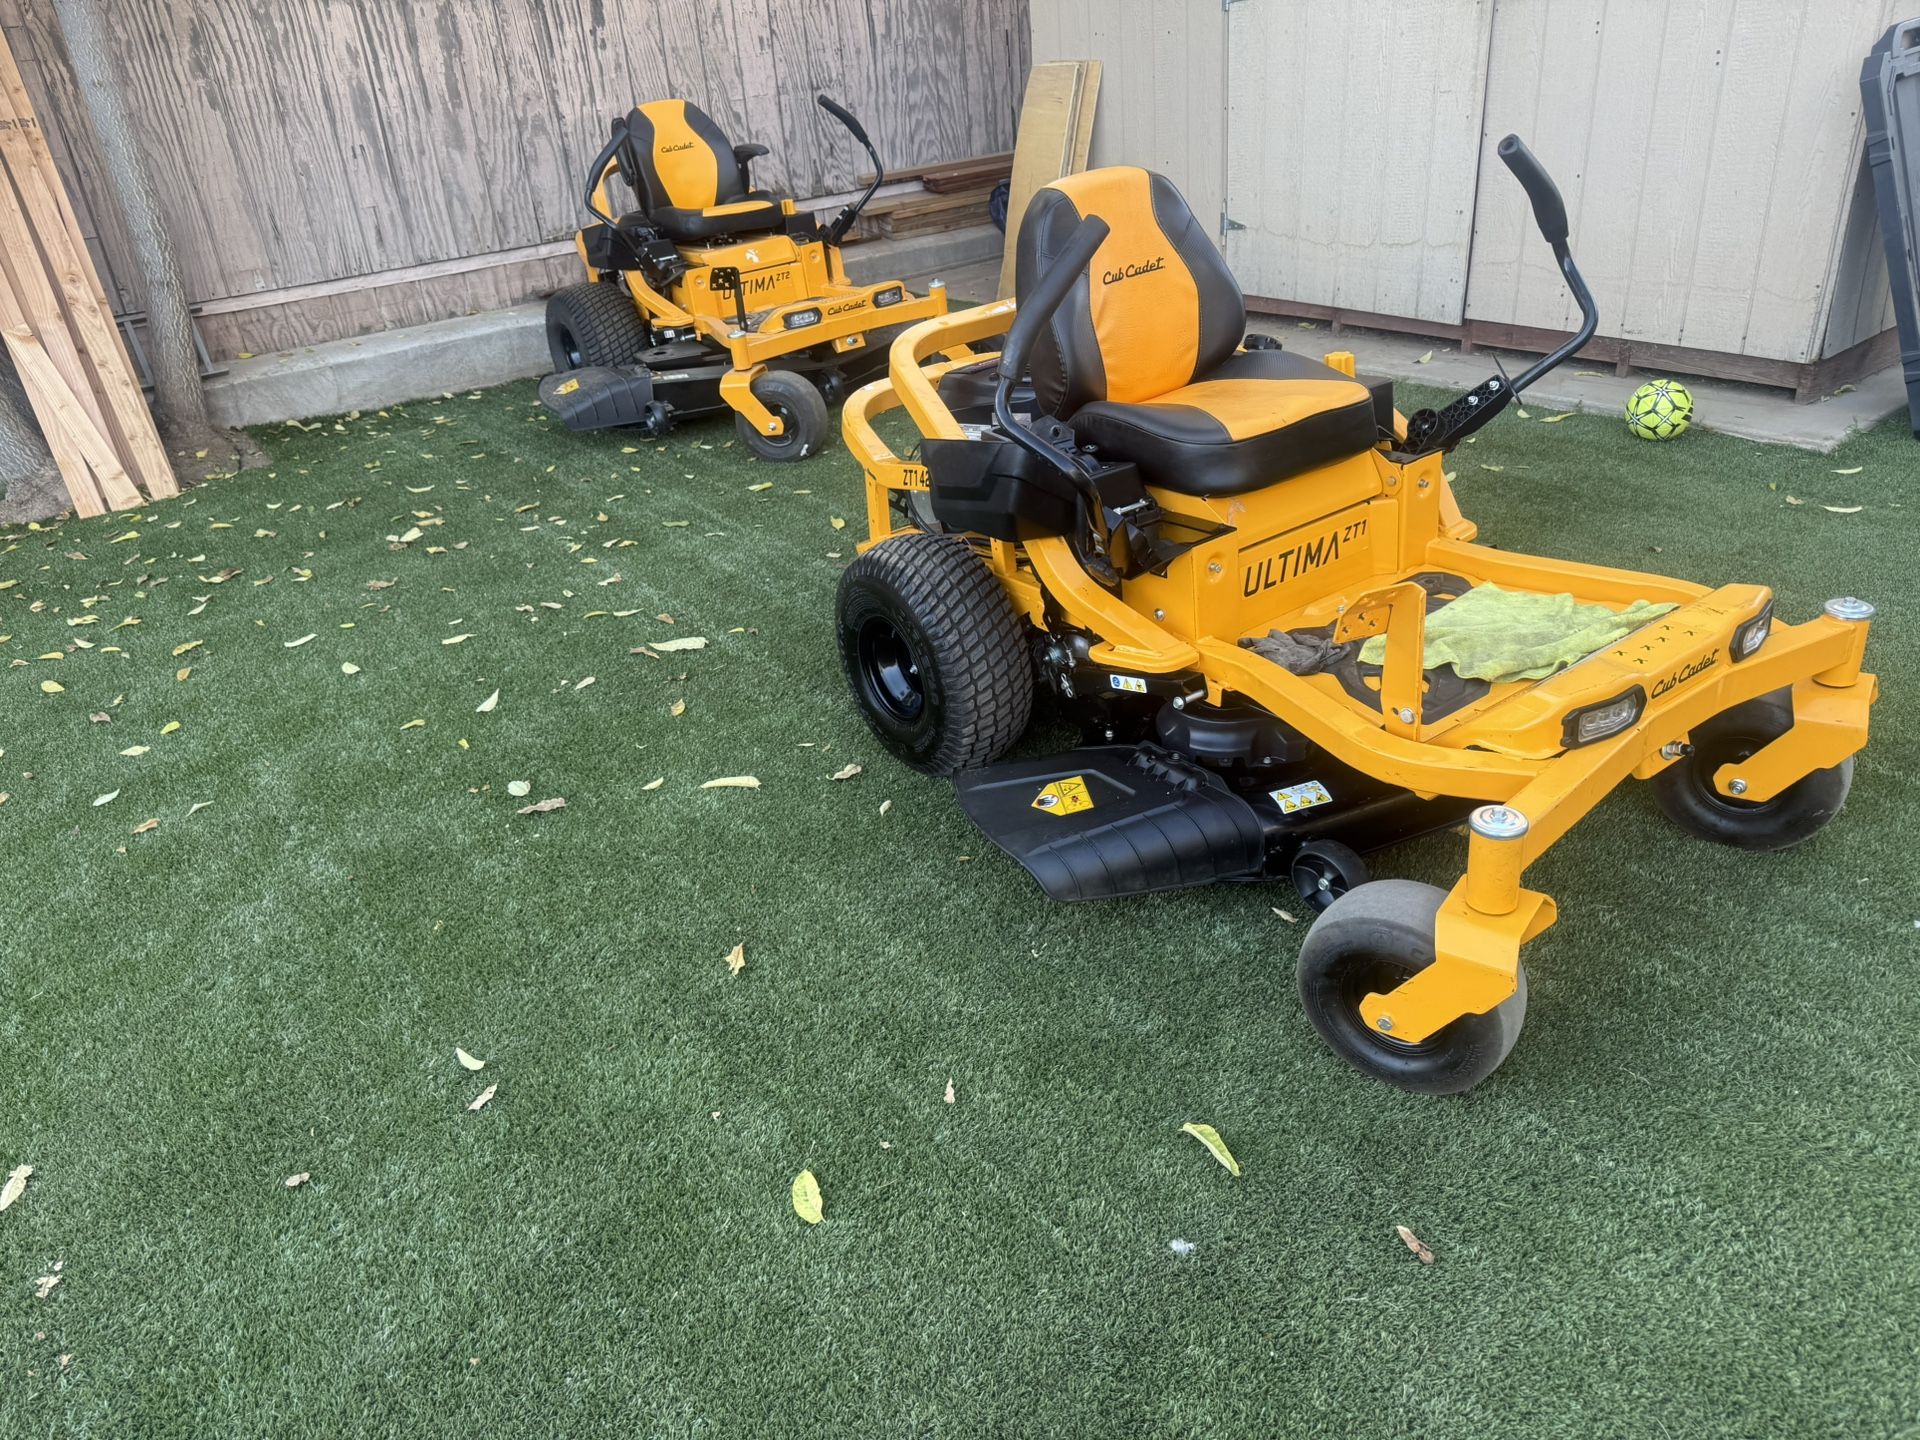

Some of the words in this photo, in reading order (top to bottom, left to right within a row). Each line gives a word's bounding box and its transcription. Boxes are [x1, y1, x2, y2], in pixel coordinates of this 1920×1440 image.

[1103, 268, 1124, 285] Cub
[1126, 256, 1165, 278] Cadet
[723, 275, 776, 300] UTIMA
[776, 271, 791, 281] ZT2
[828, 304, 843, 315] Cub
[843, 300, 867, 311] Cadet
[1244, 531, 1339, 597] ULTIMA
[1342, 519, 1367, 543] ZT1
[1651, 671, 1677, 699] Cub
[1678, 648, 1720, 683] Cadet
